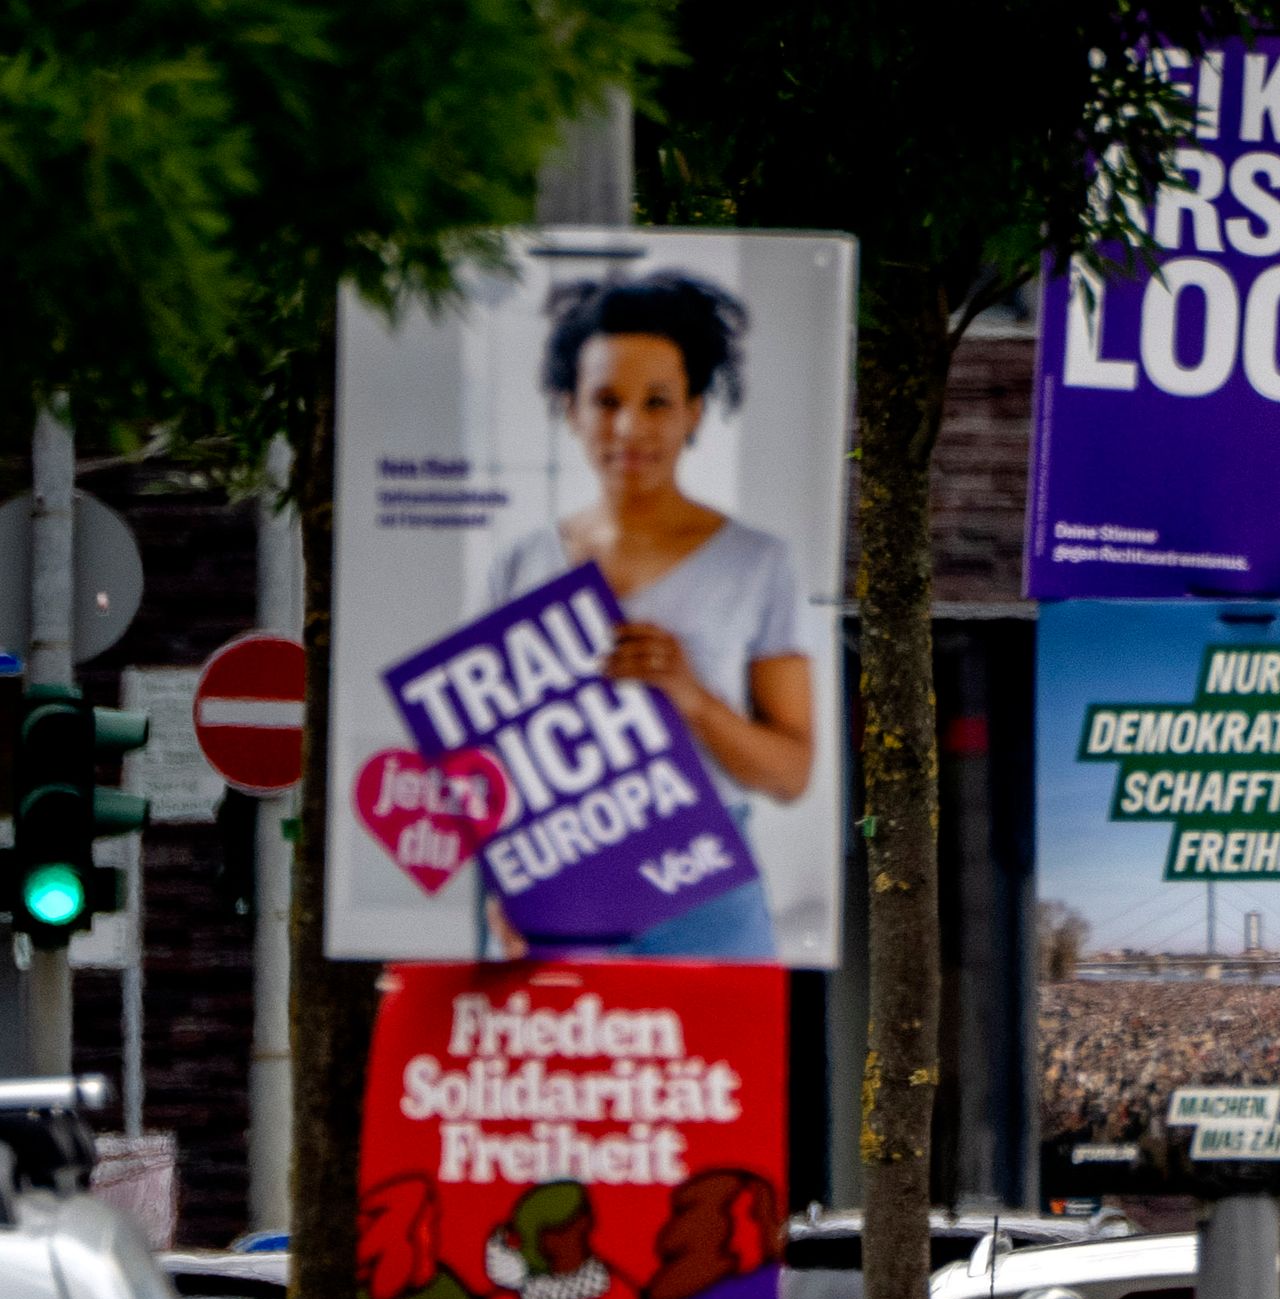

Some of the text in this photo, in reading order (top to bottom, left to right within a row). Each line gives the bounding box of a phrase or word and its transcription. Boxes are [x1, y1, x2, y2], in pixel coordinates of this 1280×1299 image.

[1053, 544, 1099, 563] gegen
[1054, 521, 1158, 545] Deine Stimme
[403, 587, 616, 748] TRAU
[498, 679, 671, 828] ICH
[398, 812, 462, 871] du
[484, 757, 698, 895] EUROPA
[640, 832, 735, 895] Volt
[449, 991, 686, 1058] Frieden
[401, 1053, 742, 1124] Solidarität
[438, 1120, 690, 1185] Freiheit
